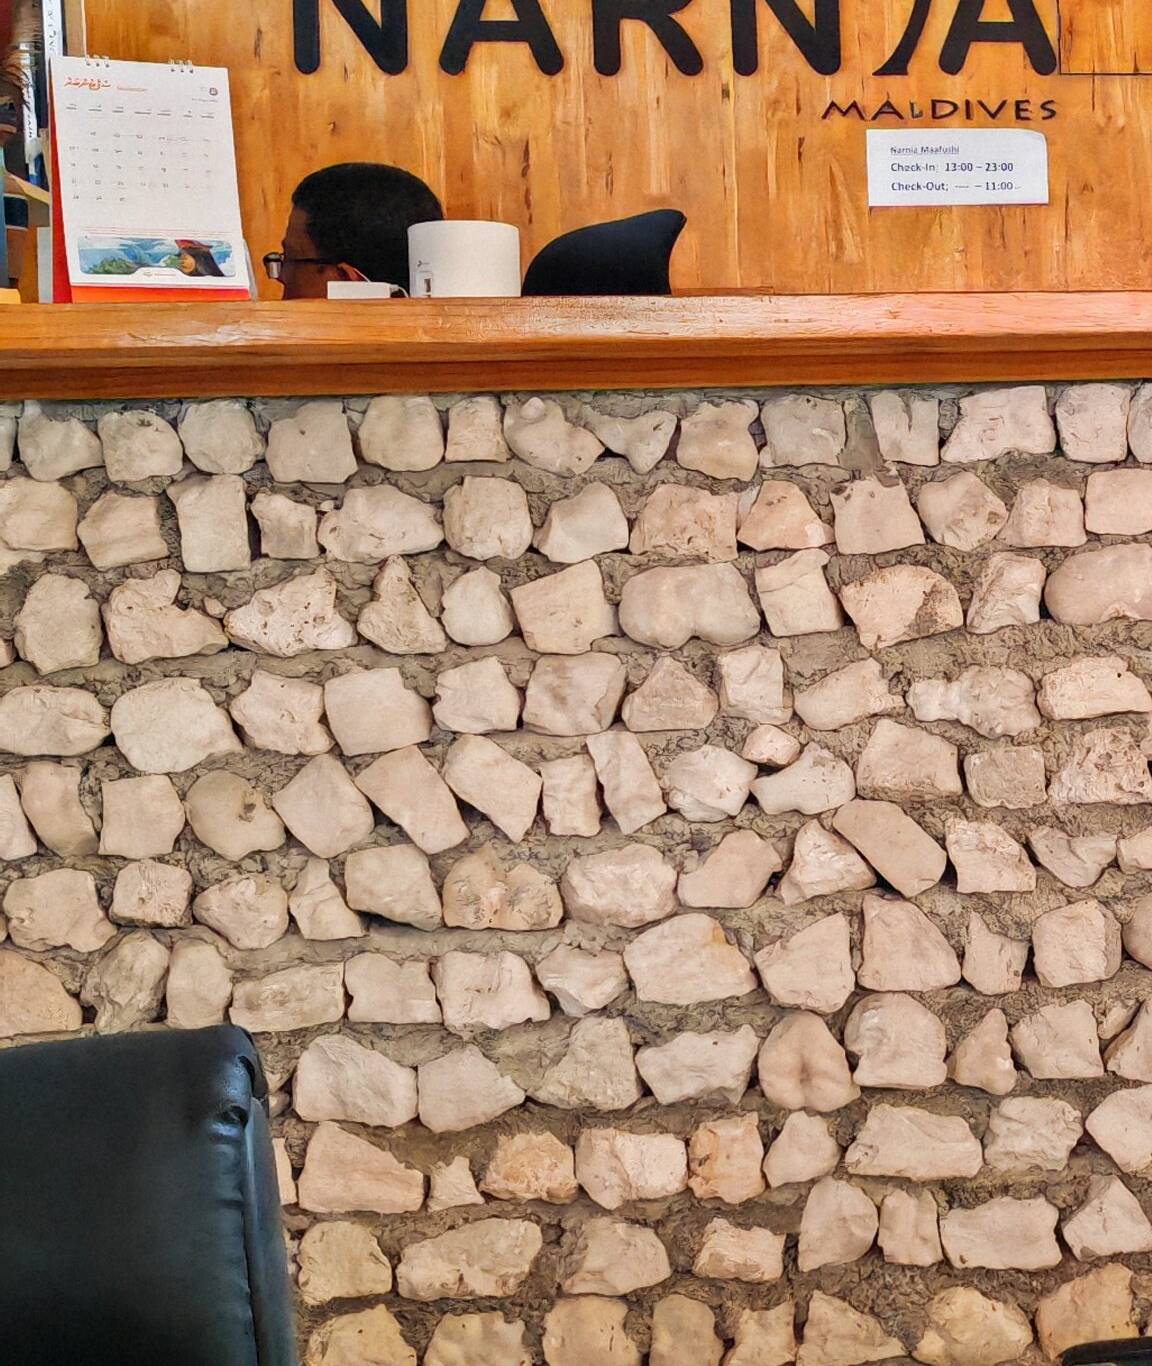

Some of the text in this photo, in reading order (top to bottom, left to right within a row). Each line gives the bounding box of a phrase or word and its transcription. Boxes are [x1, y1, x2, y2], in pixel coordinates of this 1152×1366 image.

[821, 99, 1058, 122] MALDIVES
[921, 145, 960, 154] Maafushi
[945, 162, 973, 172] 13:00
[985, 162, 1014, 172] 23:00
[985, 181, 1014, 191] 11:00
